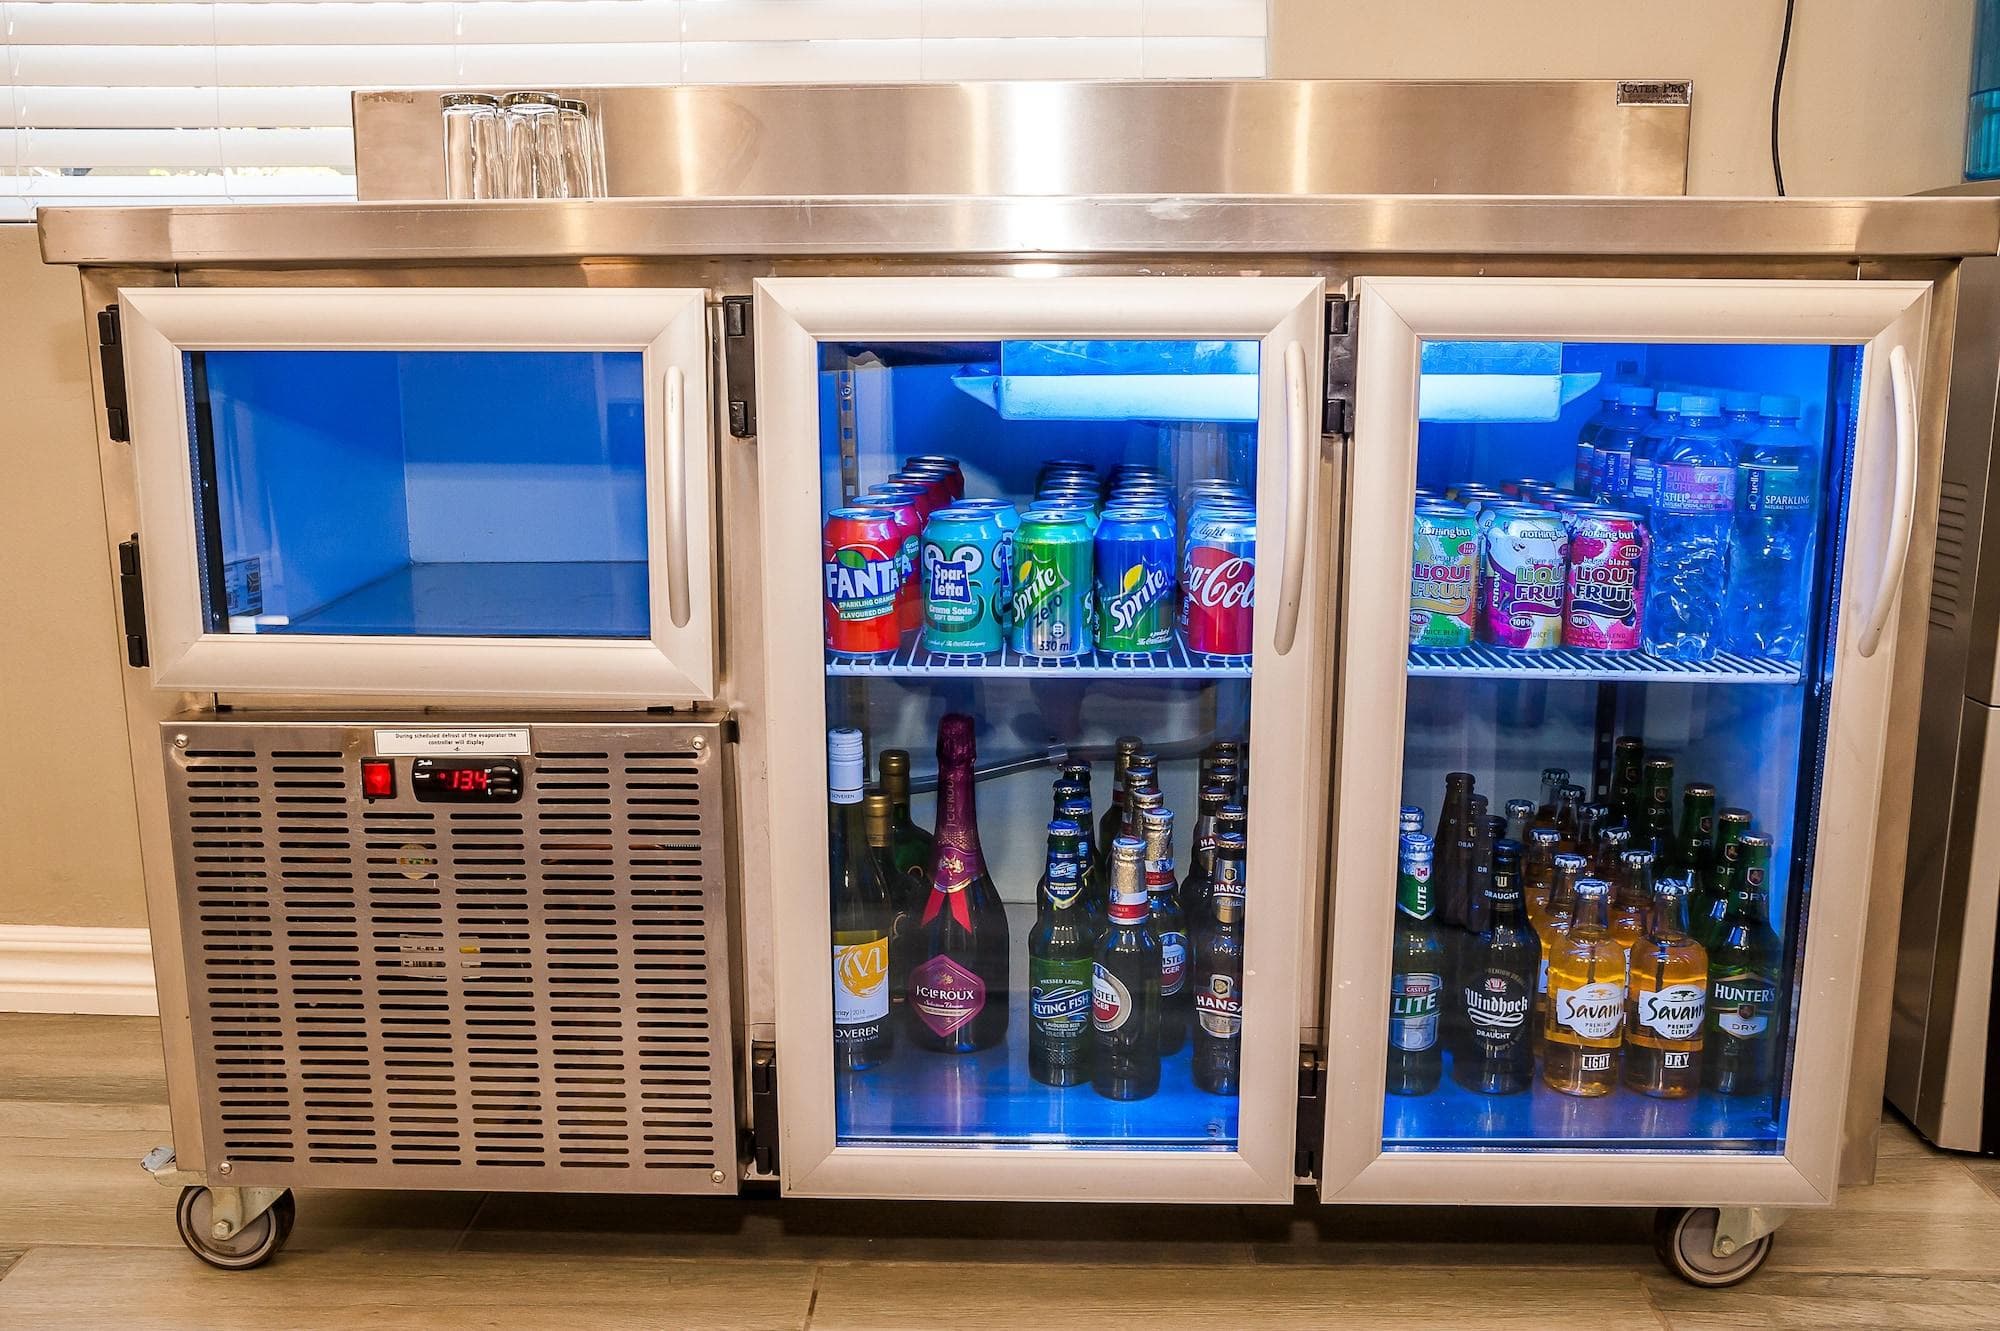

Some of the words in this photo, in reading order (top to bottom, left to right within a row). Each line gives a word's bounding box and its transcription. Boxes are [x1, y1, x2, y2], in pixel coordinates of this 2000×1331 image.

[1621, 83, 1658, 94] CATER
[1662, 83, 1686, 94] PRO
[1765, 495, 1810, 505] SPARKLING
[1199, 522, 1226, 539] light
[1608, 558, 1630, 567] blaze
[825, 560, 899, 598] FANTA
[934, 564, 966, 585] Spar-
[934, 578, 964, 597] letta
[1012, 565, 1057, 623] Sprite
[838, 599, 874, 609] SPARKLING
[1110, 568, 1165, 633] Sprite
[840, 609, 877, 619] FLAVOURED
[951, 606, 973, 616] Soda
[1033, 594, 1063, 628] zero
[1039, 640, 1058, 652] 330
[1060, 641, 1072, 651] ml
[1416, 885, 1427, 911] LITE
[1484, 889, 1520, 900] DRAUGHT
[1714, 982, 1776, 1003] HUNTER'S
[1033, 1001, 1067, 1015] FLYING
[1069, 993, 1090, 1010] FISH
[1393, 992, 1437, 1014] LITE
[1465, 987, 1529, 1014] Windhoek
[1584, 1021, 1611, 1029] PREMIUM
[1667, 1022, 1694, 1030] PREMIUM
[1671, 1028, 1690, 1036] CIDER
[1732, 1023, 1758, 1032] DRY
[1476, 1028, 1511, 1040] DRAUGHT
[1582, 1054, 1611, 1070] LIGHT
[1664, 1053, 1690, 1068] DRY
